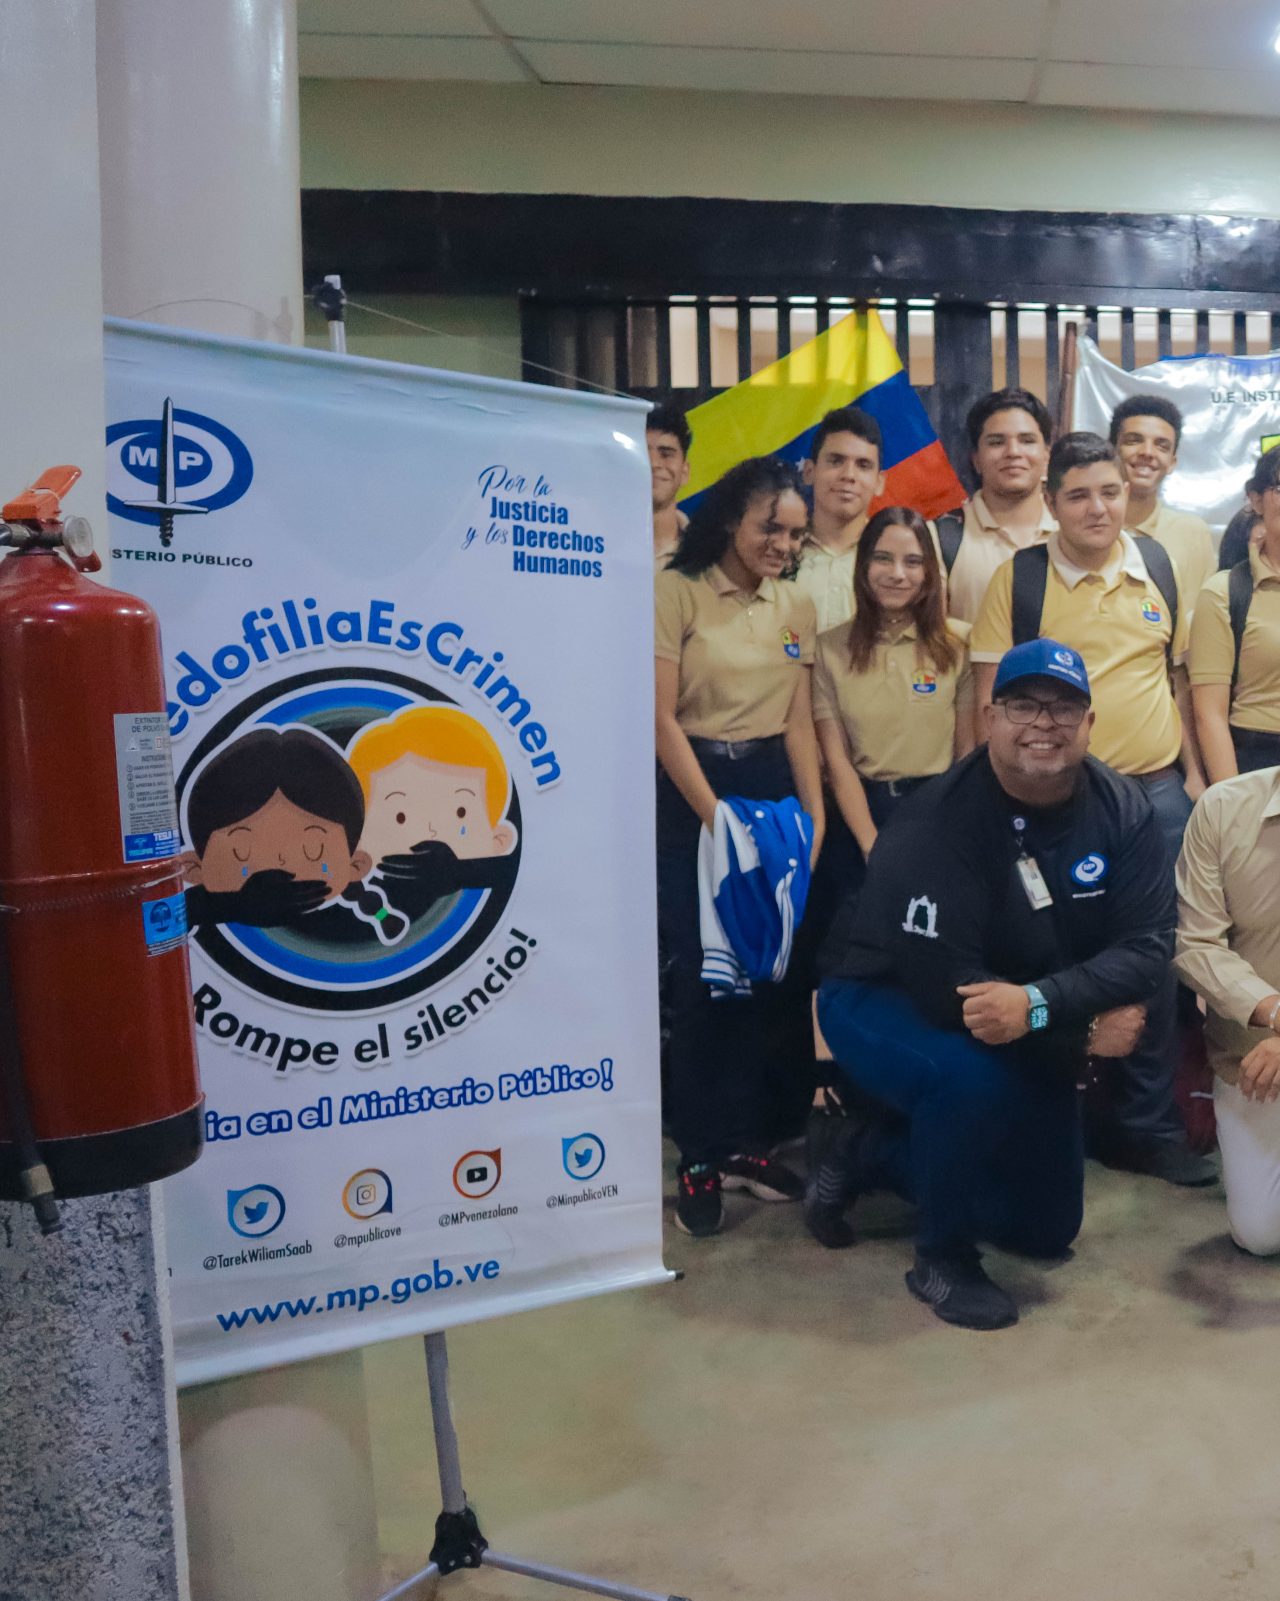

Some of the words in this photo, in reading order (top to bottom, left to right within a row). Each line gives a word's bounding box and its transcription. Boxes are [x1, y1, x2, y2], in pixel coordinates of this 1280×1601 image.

[478, 465, 527, 498] Por
[533, 475, 553, 498] la
[490, 496, 569, 525] Justicia
[461, 526, 478, 550] y
[485, 522, 509, 545] los
[512, 524, 605, 554] Derechos
[111, 549, 176, 563] STERIO
[181, 552, 253, 568] PÚBLICO
[513, 551, 603, 578] Humanos
[167, 597, 562, 786] edofiliaEsCrimen
[193, 982, 340, 1073] Rompe
[354, 1022, 390, 1063] el
[403, 927, 538, 1051] silencio!
[246, 1106, 293, 1136] en
[298, 1096, 332, 1130] el
[339, 1077, 494, 1125] Ministerio
[498, 1058, 614, 1101] Público!
[546, 1184, 619, 1209] @MinpublicoVEN
[438, 1204, 519, 1228] @MPvenezolano
[333, 1225, 402, 1248] @mpublicove
[203, 1240, 313, 1271] @TarekWiliamSaab
[216, 1259, 500, 1332] www.mp.gob.ve
